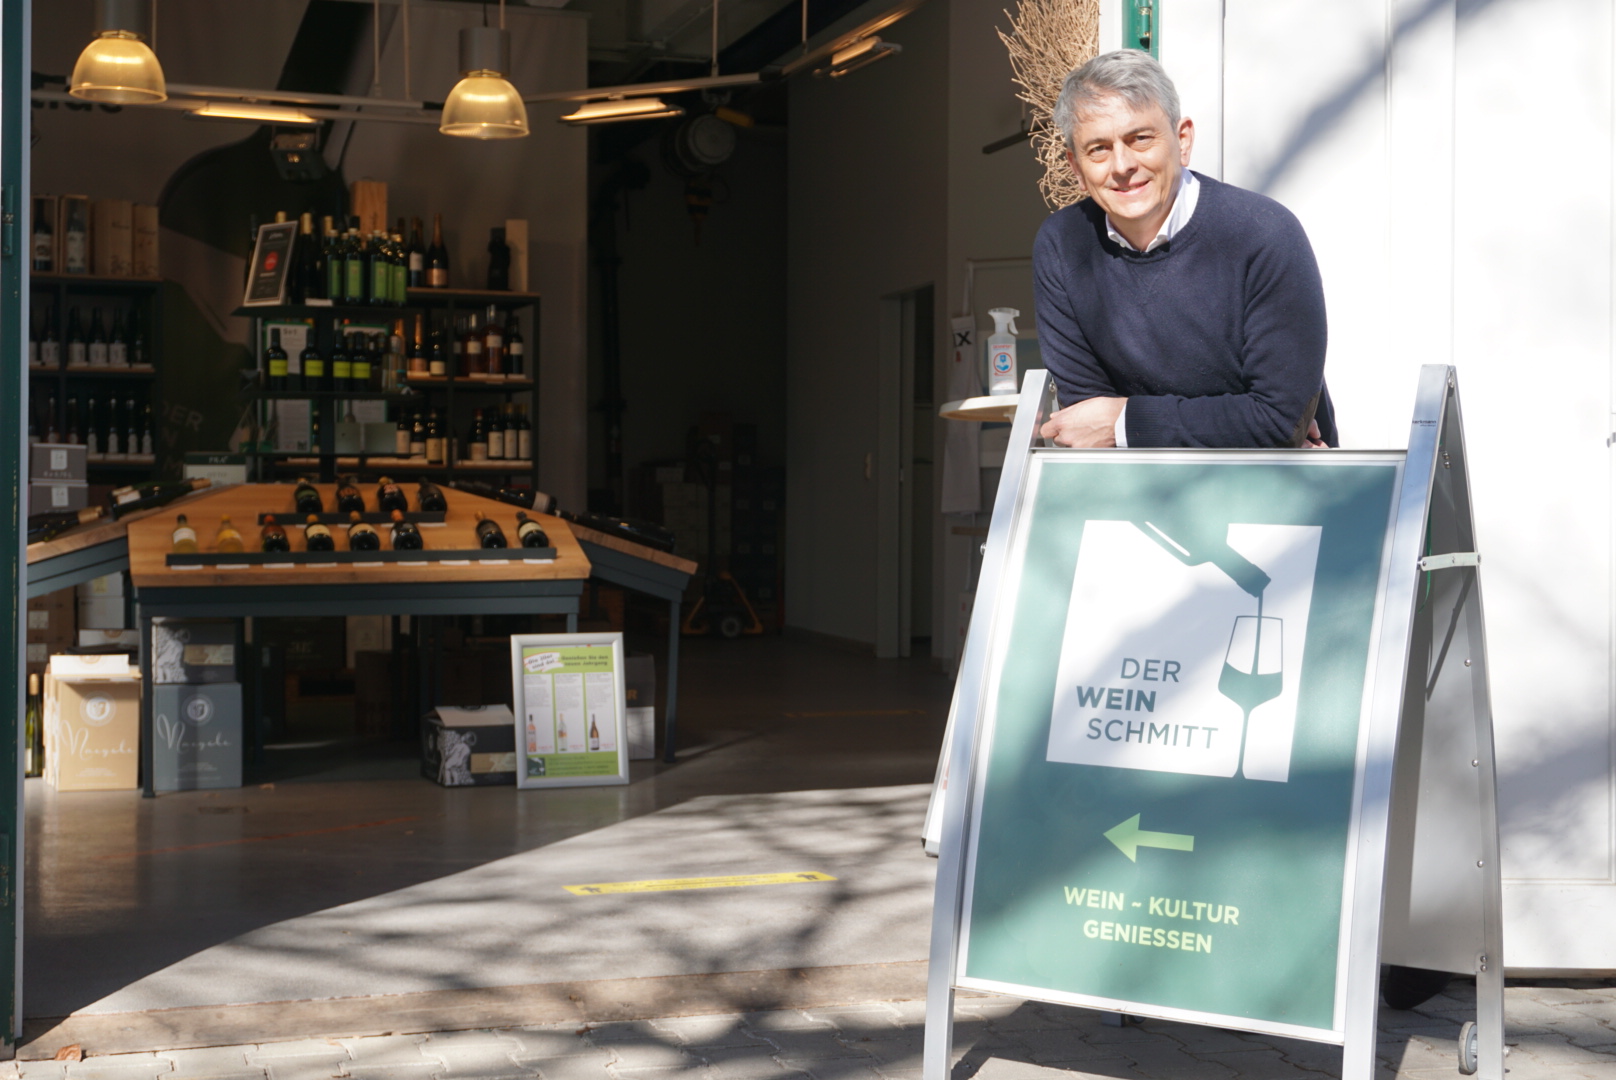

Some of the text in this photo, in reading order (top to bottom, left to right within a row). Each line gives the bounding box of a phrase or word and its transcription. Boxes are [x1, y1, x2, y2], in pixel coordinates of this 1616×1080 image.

[1120, 657, 1182, 684] DER
[1076, 685, 1157, 713] WEIN
[1086, 717, 1219, 749] SCHMITT
[1063, 885, 1125, 911] WEIN
[1149, 896, 1240, 926] KULTUR
[1083, 919, 1213, 954] GENIESSEN
